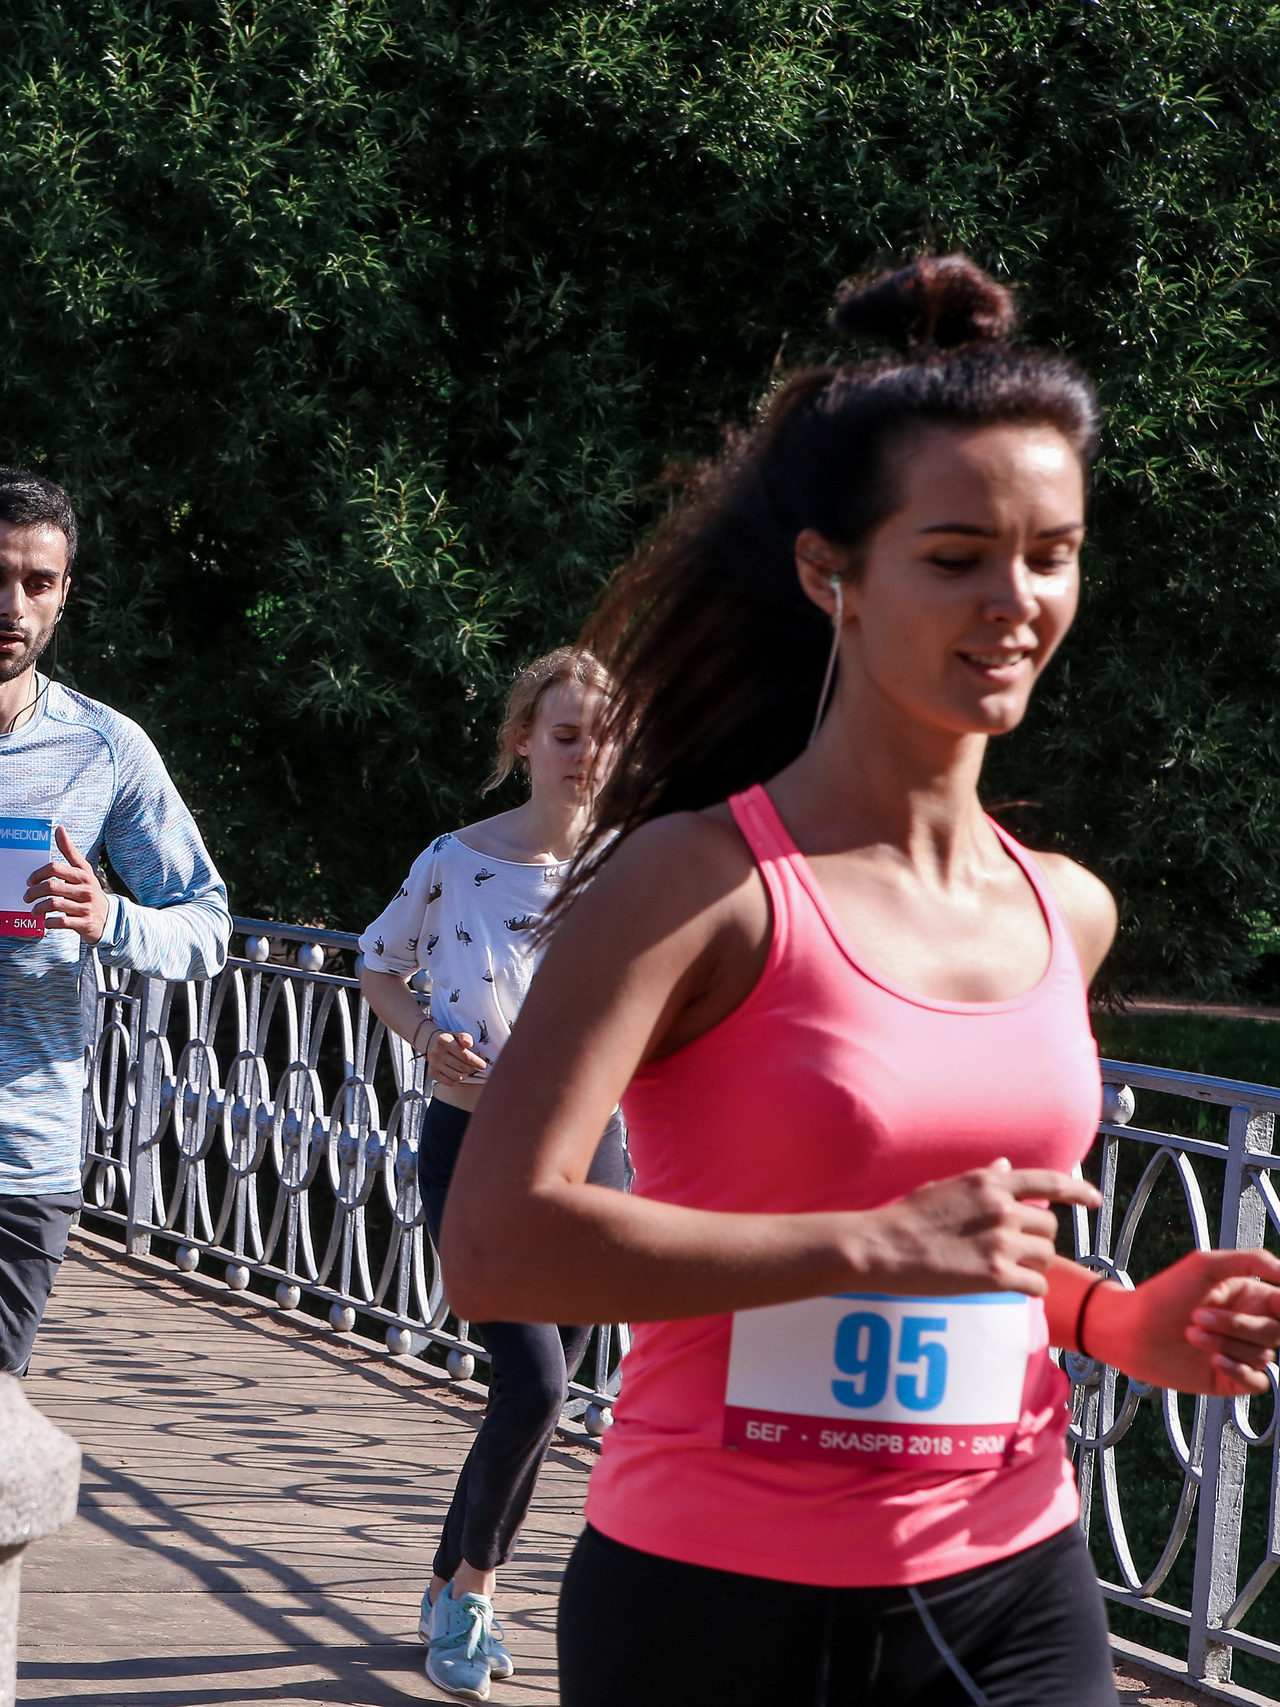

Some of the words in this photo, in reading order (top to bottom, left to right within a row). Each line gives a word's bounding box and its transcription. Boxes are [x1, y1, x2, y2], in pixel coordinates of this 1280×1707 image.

[831, 1311, 948, 1411] 95
[746, 1421, 788, 1443] БЕГ
[820, 1430, 903, 1453] 5KASPB
[908, 1435, 952, 1455] 2018
